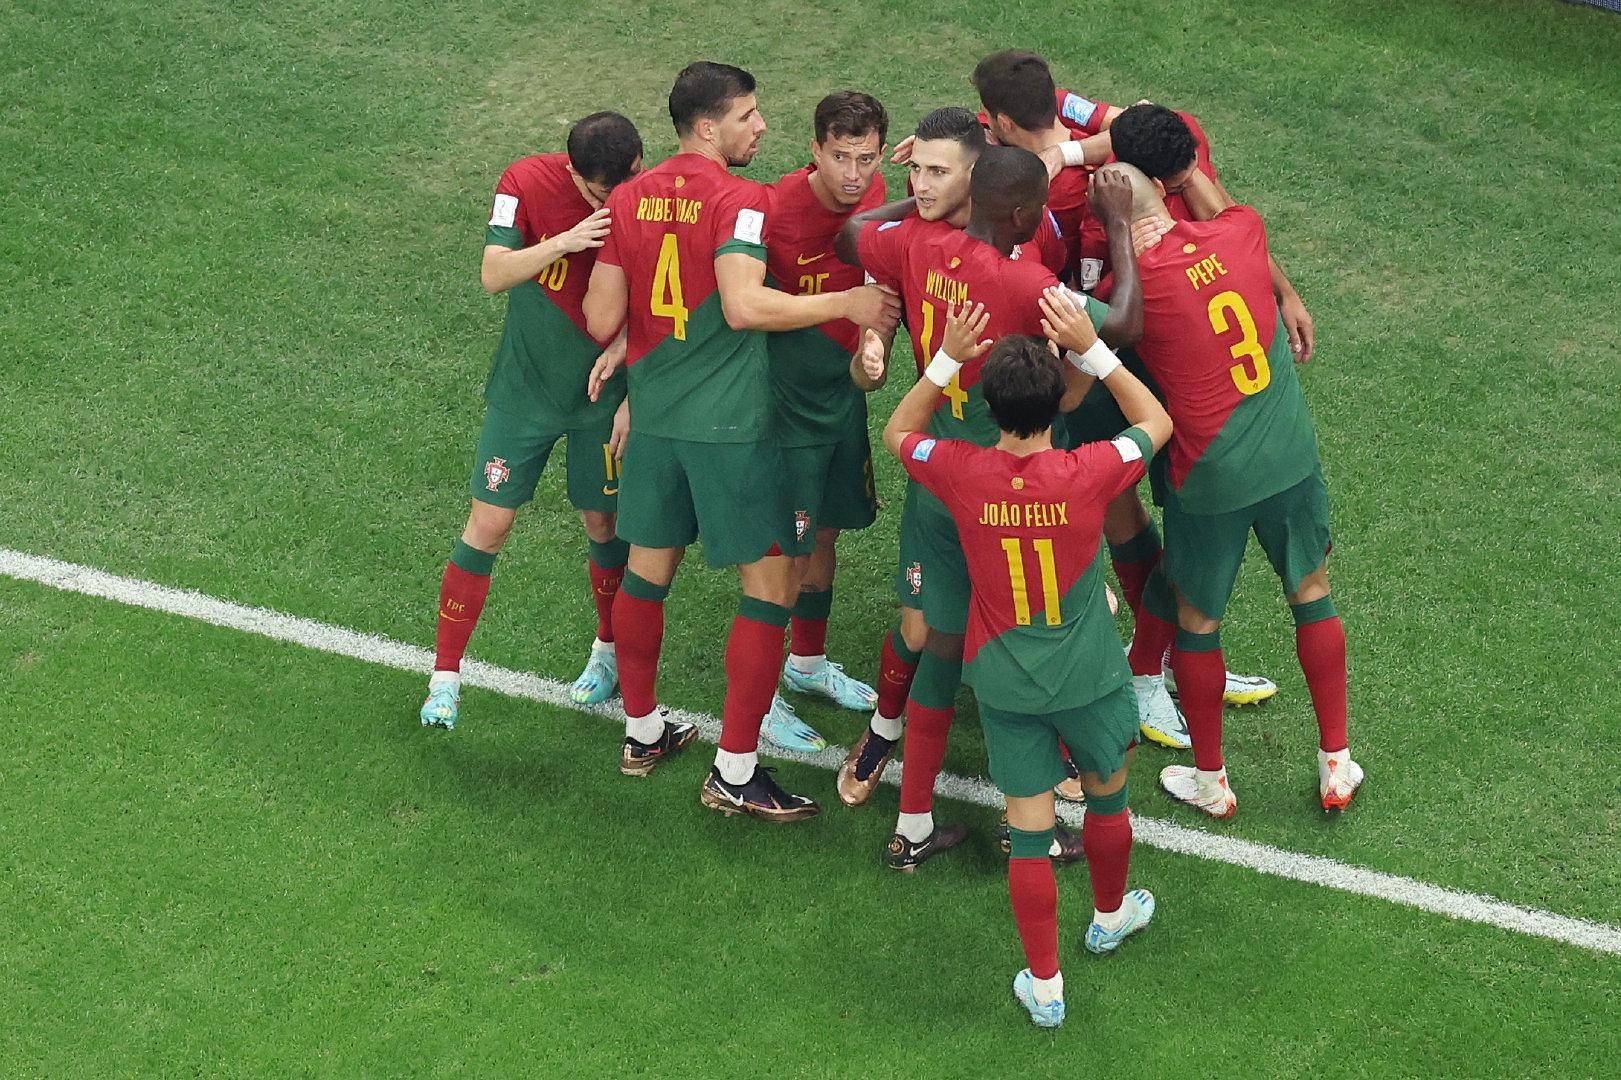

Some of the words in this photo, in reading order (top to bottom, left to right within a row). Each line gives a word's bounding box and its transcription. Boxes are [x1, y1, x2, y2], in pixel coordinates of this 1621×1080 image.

[636, 195, 675, 222] RÚBE
[651, 233, 688, 341] 4
[925, 268, 969, 308] WILLIAM
[1185, 253, 1229, 291] PEPE
[1207, 290, 1271, 395] 3
[979, 501, 1020, 527] JOÃO
[1025, 501, 1069, 528] FÉLIX
[1001, 537, 1062, 626] 11
